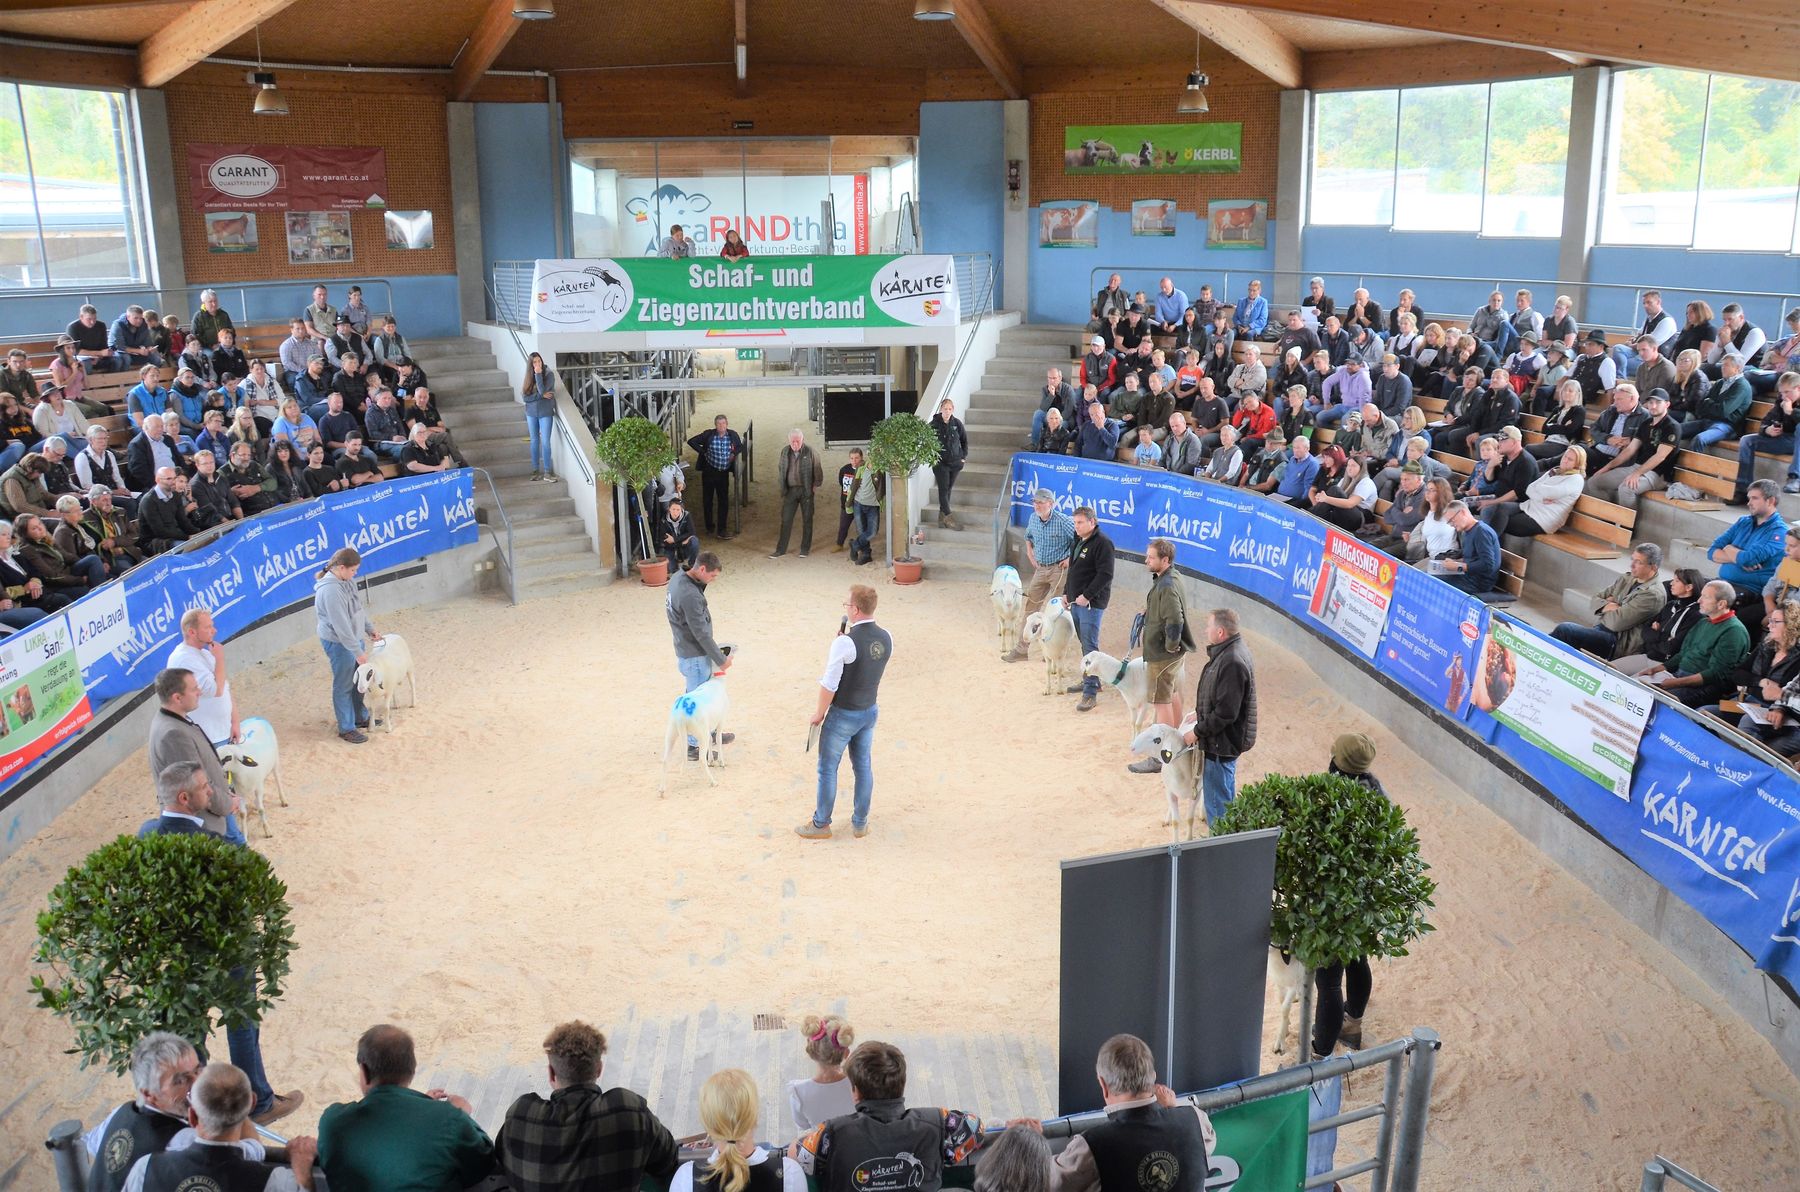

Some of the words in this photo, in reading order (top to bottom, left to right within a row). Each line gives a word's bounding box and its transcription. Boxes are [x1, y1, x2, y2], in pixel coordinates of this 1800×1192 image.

[1193, 148, 1237, 160] KERBL
[217, 166, 269, 177] GARANT
[680, 215, 847, 242] aRINDtha
[856, 182, 865, 253] www.carindthia.at
[689, 263, 764, 289] Schaf-
[772, 262, 814, 287] und
[637, 296, 866, 326] Ziegenzuchtverband
[1018, 458, 1055, 470] www.kaernten.at
[1082, 471, 1120, 482] www.kaernten.at
[398, 479, 440, 494] www.kaernten.at
[331, 496, 371, 511] www.kaernten.at
[1331, 536, 1380, 577] HARGASSNER
[89, 603, 125, 638] DeLaval
[1397, 604, 1407, 617] Wir
[1406, 611, 1418, 624] sind
[24, 631, 47, 653] LIKRA
[44, 641, 61, 659] San
[1391, 630, 1402, 642] und
[1401, 637, 1415, 650] zwar
[1393, 617, 1429, 646] österreichische
[1429, 638, 1448, 658] Bauern
[1495, 631, 1553, 668] ÖKOLOGISCHE
[1554, 663, 1597, 692] PELLETS
[1602, 690, 1645, 717] ecolets
[1594, 745, 1632, 771] ecolets.at
[1659, 732, 1711, 770] www.kaernten.at
